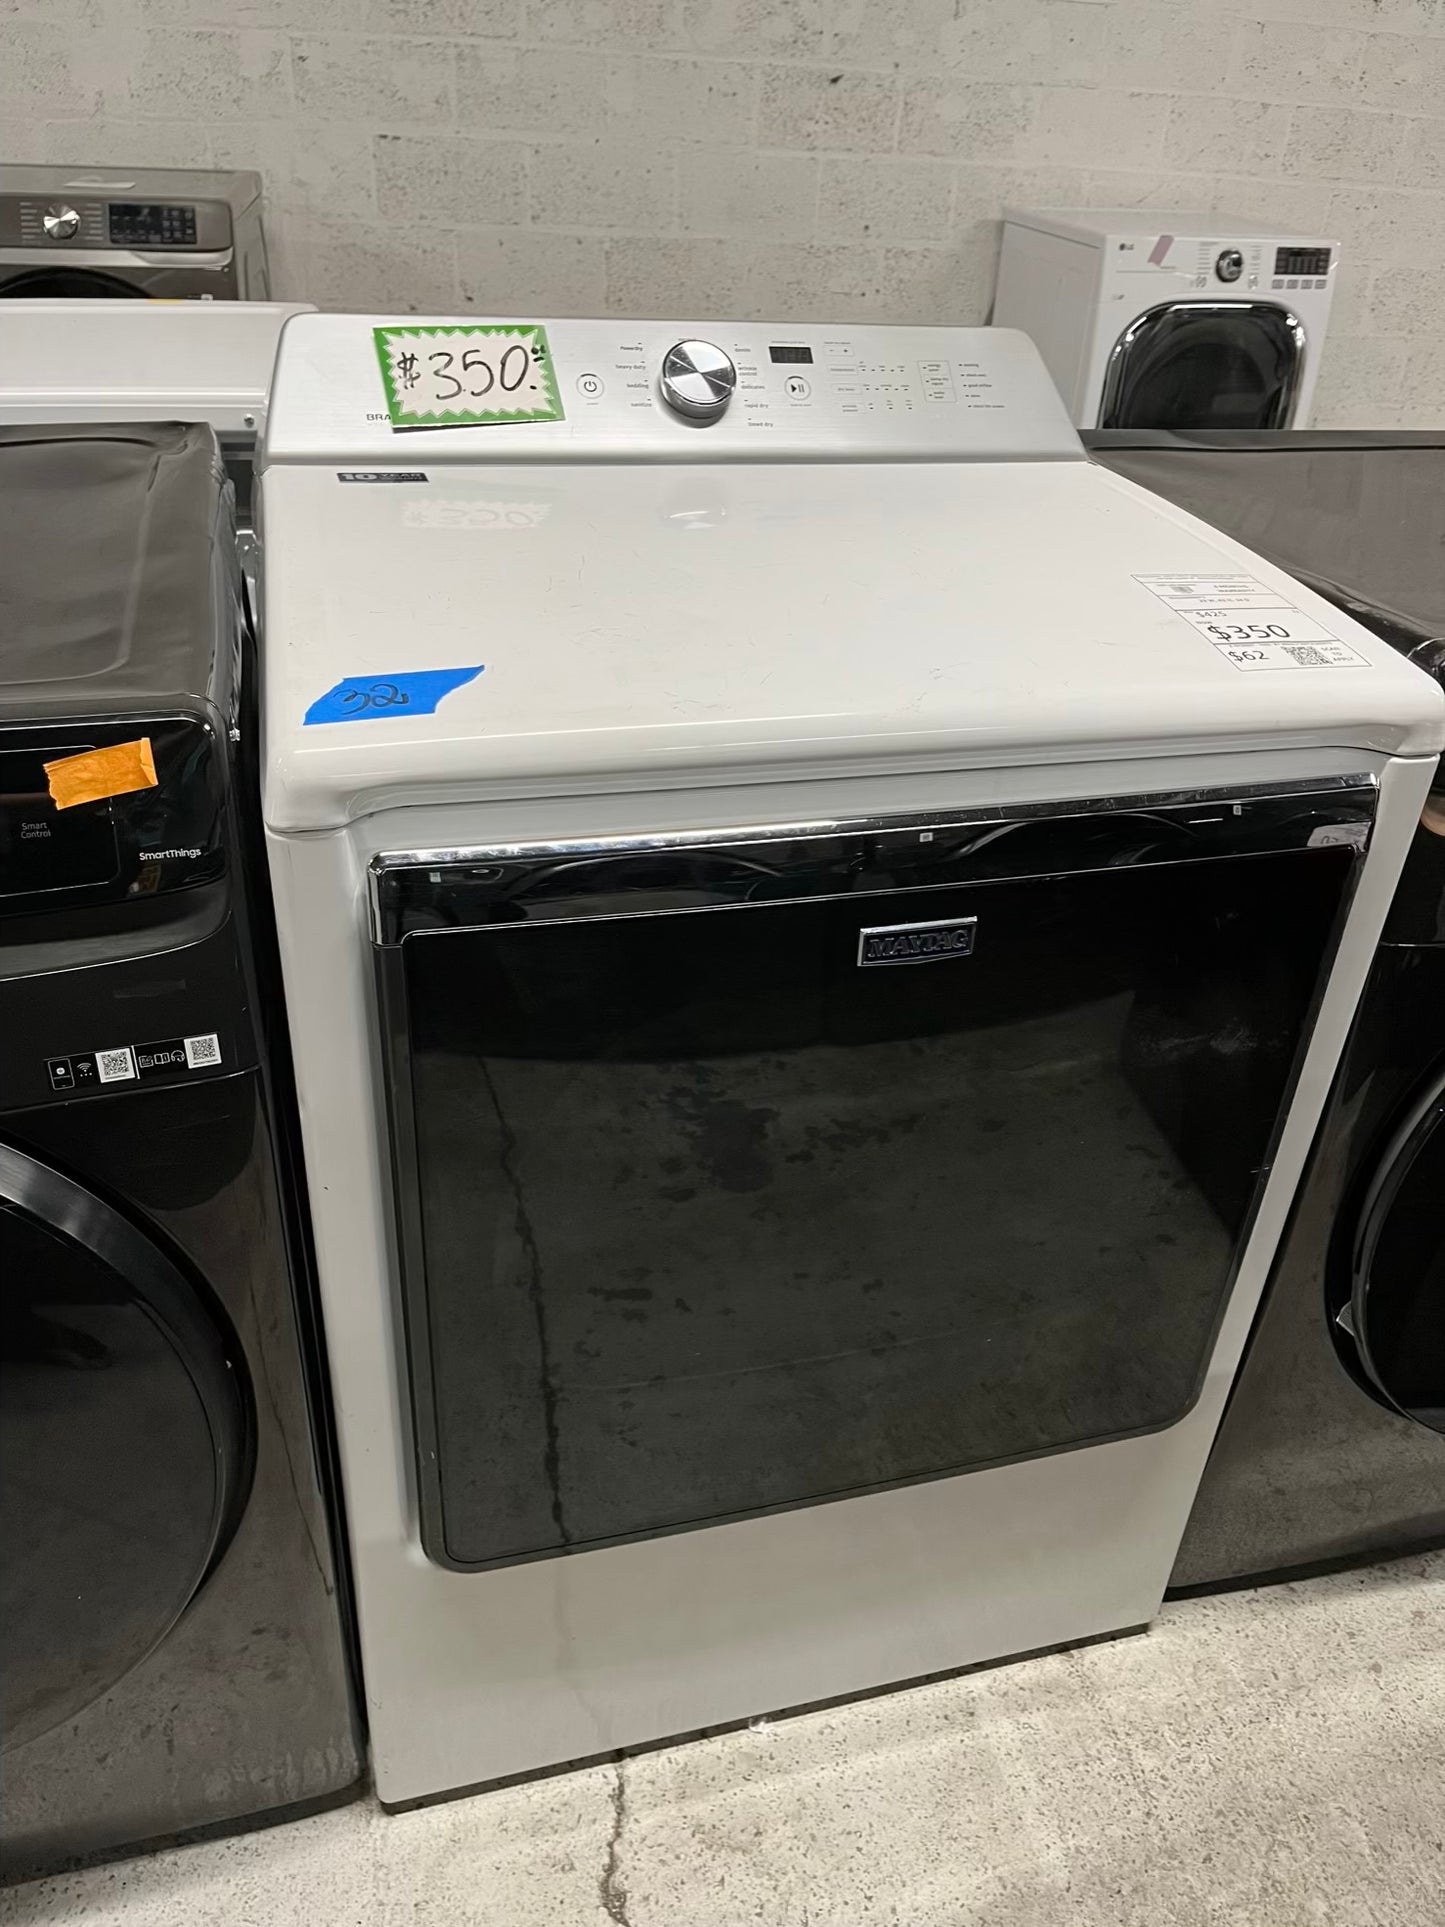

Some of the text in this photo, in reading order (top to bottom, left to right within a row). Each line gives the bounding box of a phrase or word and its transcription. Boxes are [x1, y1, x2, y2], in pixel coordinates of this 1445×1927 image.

[342, 473, 378, 481] 10
[1196, 611, 1228, 619] $425
[1207, 623, 1291, 642] $350
[1228, 650, 1271, 663] $62
[333, 683, 410, 716] 32
[21, 821, 48, 831] Smart
[20, 831, 51, 840] Control
[139, 848, 202, 861] SmartThings
[867, 929, 969, 958] MAYTAG
